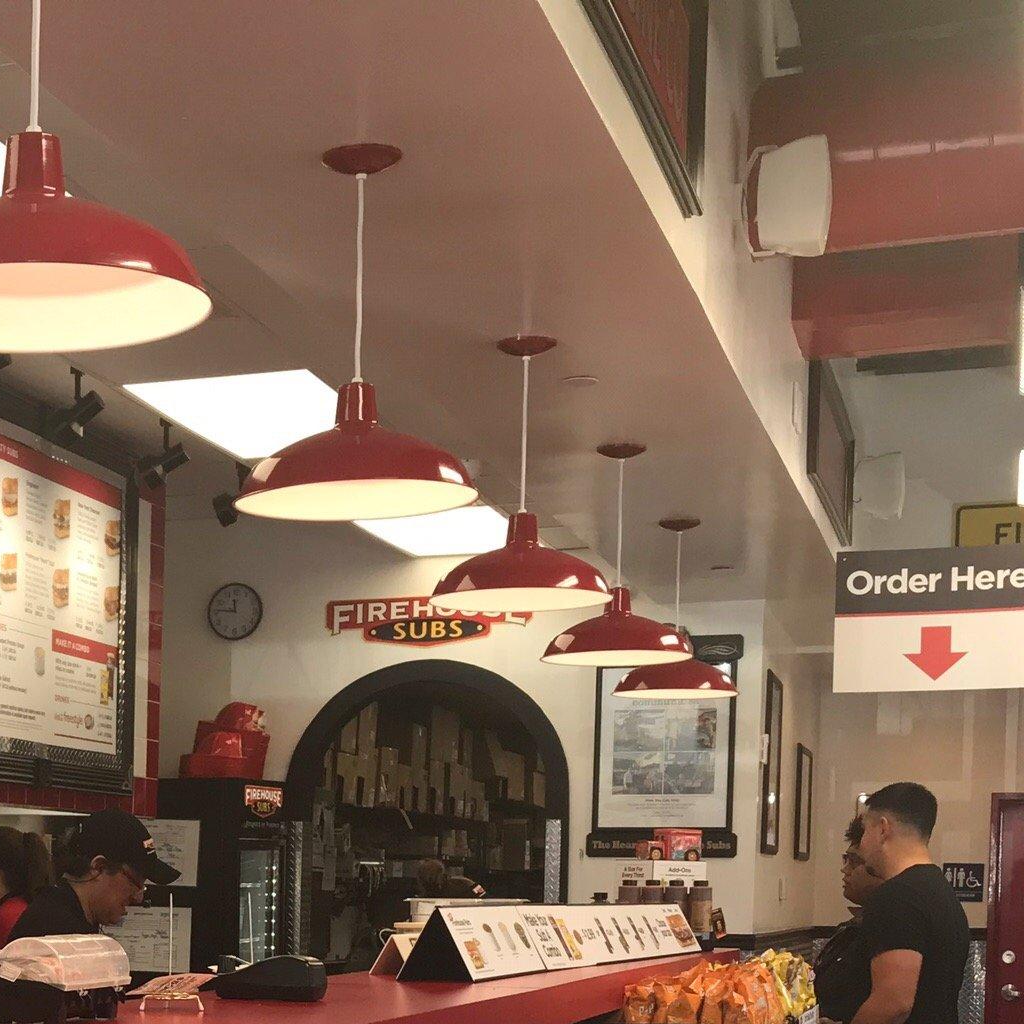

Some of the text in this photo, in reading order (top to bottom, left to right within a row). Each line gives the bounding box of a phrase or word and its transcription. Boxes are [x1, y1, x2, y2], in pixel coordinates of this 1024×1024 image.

[846, 565, 1024, 595] Order Here
[332, 600, 527, 637] FIREH
[393, 620, 463, 640] SUBS
[246, 788, 282, 807] FIREHOUSE
[593, 840, 731, 850] The Subs
[668, 866, 691, 874] Add-Ons
